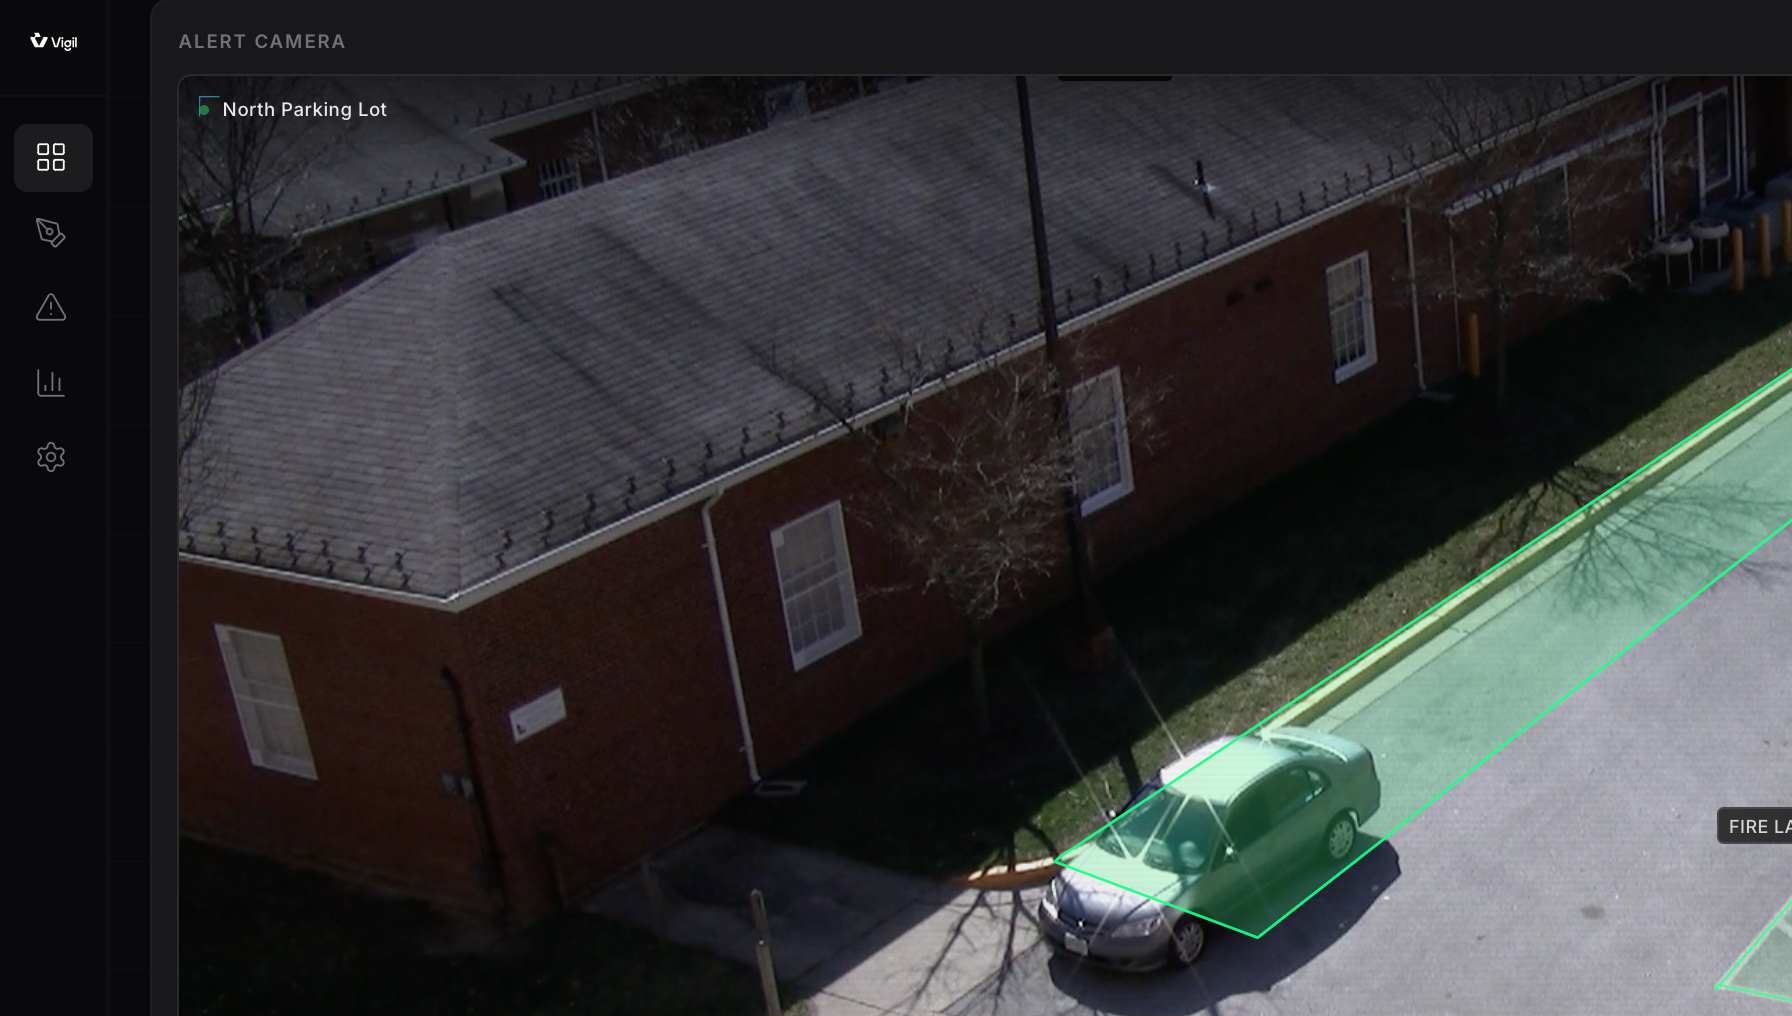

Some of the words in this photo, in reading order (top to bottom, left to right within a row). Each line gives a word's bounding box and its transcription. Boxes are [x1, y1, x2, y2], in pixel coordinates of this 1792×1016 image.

[50, 36, 78, 52] Vigil
[178, 33, 246, 49] ALERT
[254, 33, 345, 49] CAMERA
